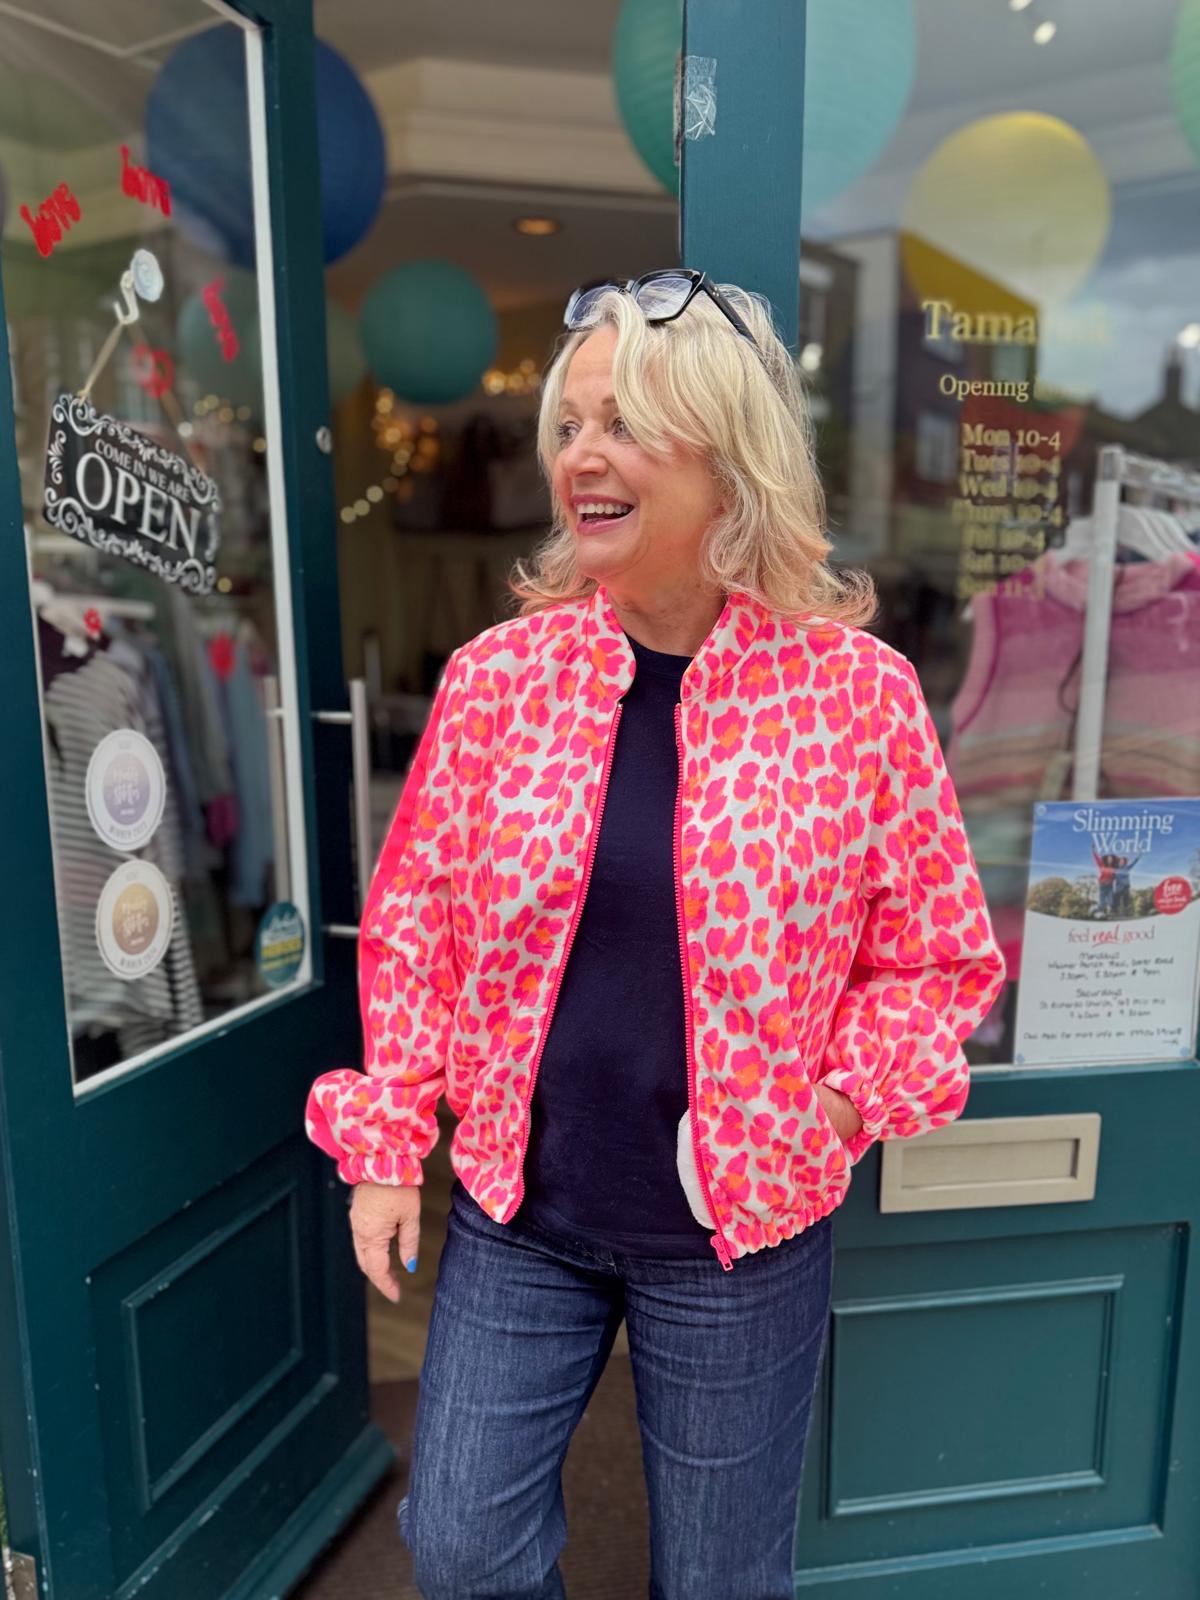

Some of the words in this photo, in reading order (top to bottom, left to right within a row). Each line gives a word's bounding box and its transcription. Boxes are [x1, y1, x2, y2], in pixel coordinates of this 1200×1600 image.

[940, 374, 1029, 401] Opening
[962, 423, 1010, 447] Mon
[1017, 429, 1061, 452] 10-4
[95, 439, 131, 471] COME
[133, 463, 147, 481] IN
[148, 469, 166, 491] WE
[167, 479, 190, 503] ARE
[76, 452, 201, 559] OPEN
[1073, 809, 1174, 834] Slimming
[1092, 831, 1152, 854] World
[1068, 928, 1090, 944] feel
[1092, 924, 1120, 947] real
[1123, 926, 1155, 945] good
